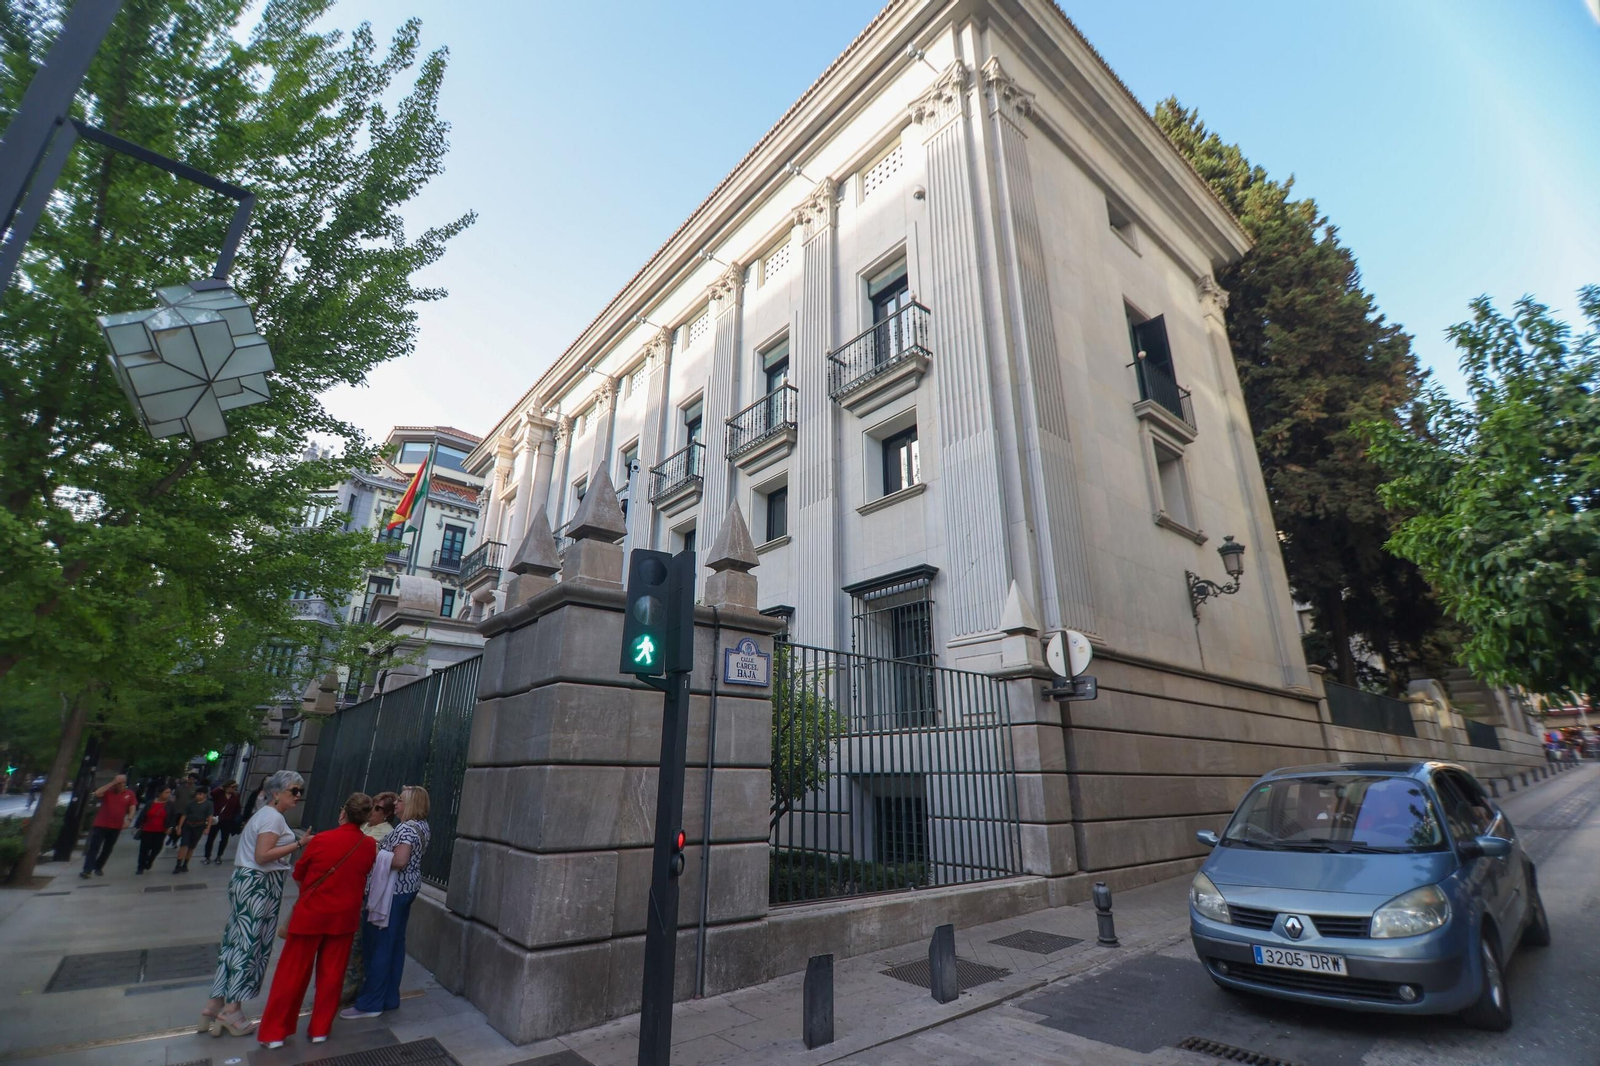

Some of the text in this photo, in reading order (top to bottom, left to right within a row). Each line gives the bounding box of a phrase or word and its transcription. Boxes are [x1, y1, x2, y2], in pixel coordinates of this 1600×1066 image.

[737, 669, 756, 679] BAJA
[1265, 949, 1341, 972] 3205 DRW
